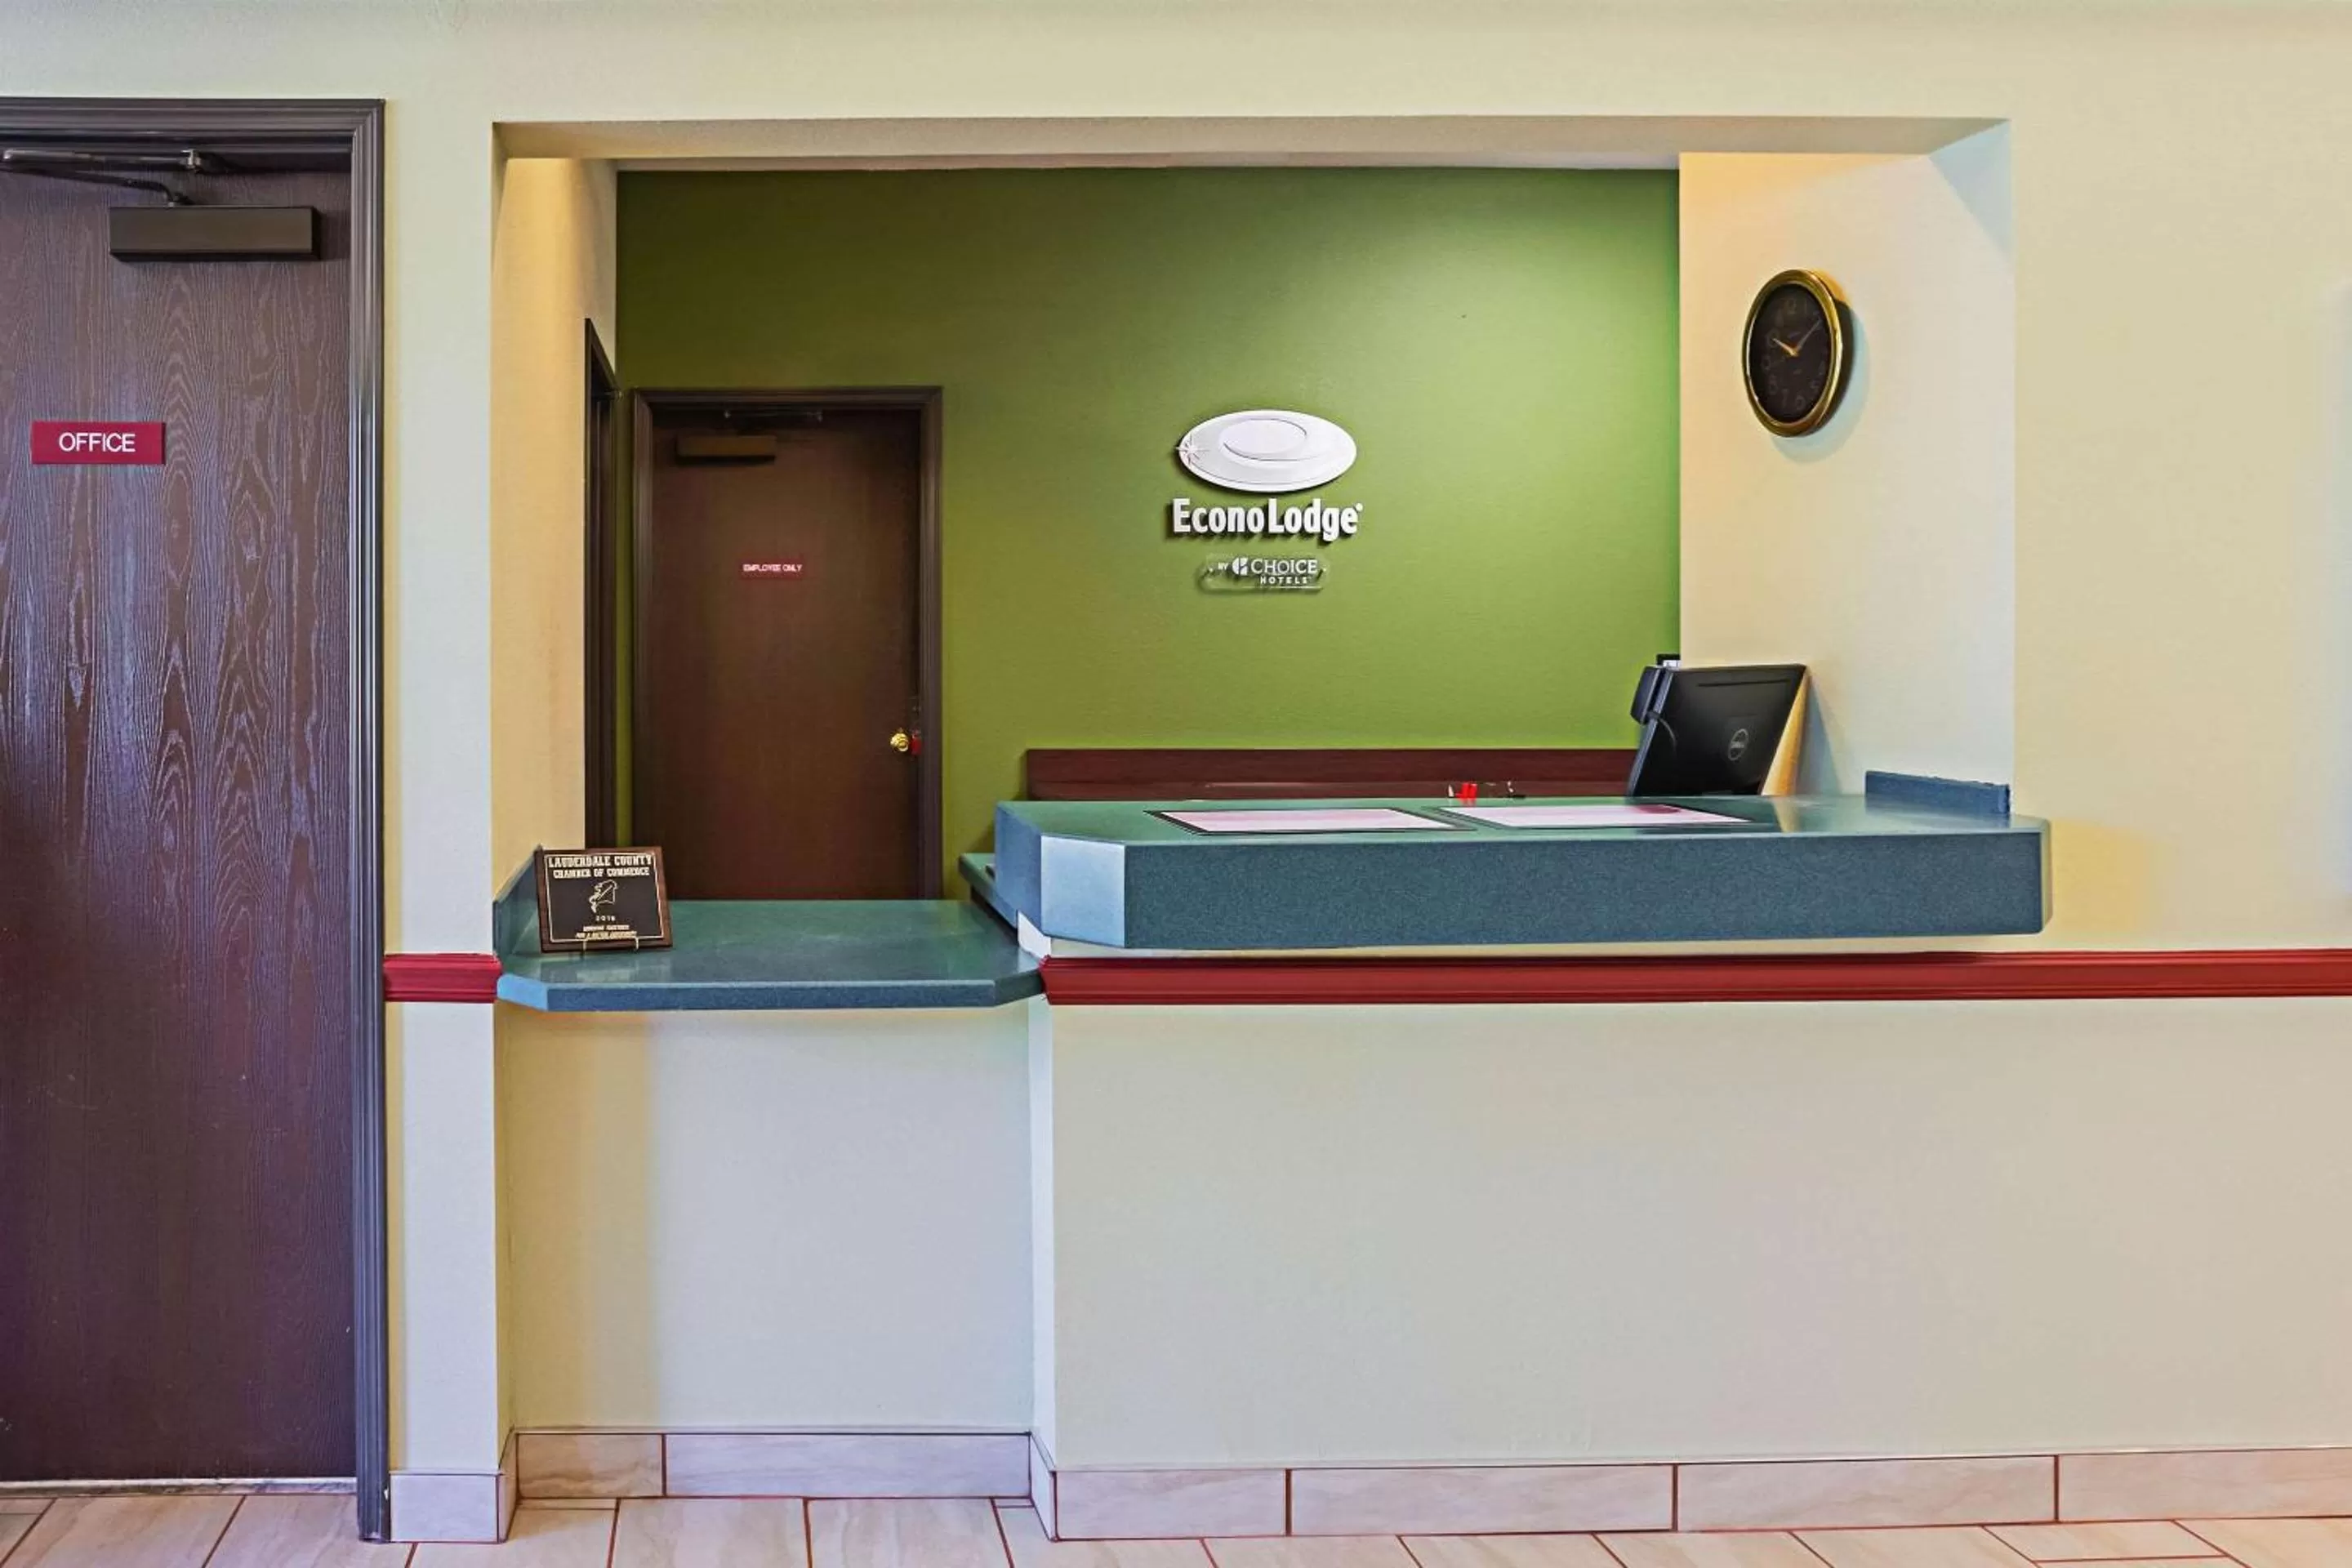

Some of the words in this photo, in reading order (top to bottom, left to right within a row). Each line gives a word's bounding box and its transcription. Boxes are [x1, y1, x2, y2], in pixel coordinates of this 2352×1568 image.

[59, 432, 136, 452] OFFICE
[742, 564, 782, 572] EMPLOYEE
[782, 564, 803, 572] ONLY
[1250, 559, 1317, 574] CHOICE
[1260, 576, 1307, 584] HOTELS
[548, 857, 611, 867] LAUDERDALE
[614, 854, 652, 866] COUNTY
[553, 868, 591, 879] CHAMBER
[594, 867, 604, 877] OF
[607, 866, 650, 876] COMMERCE
